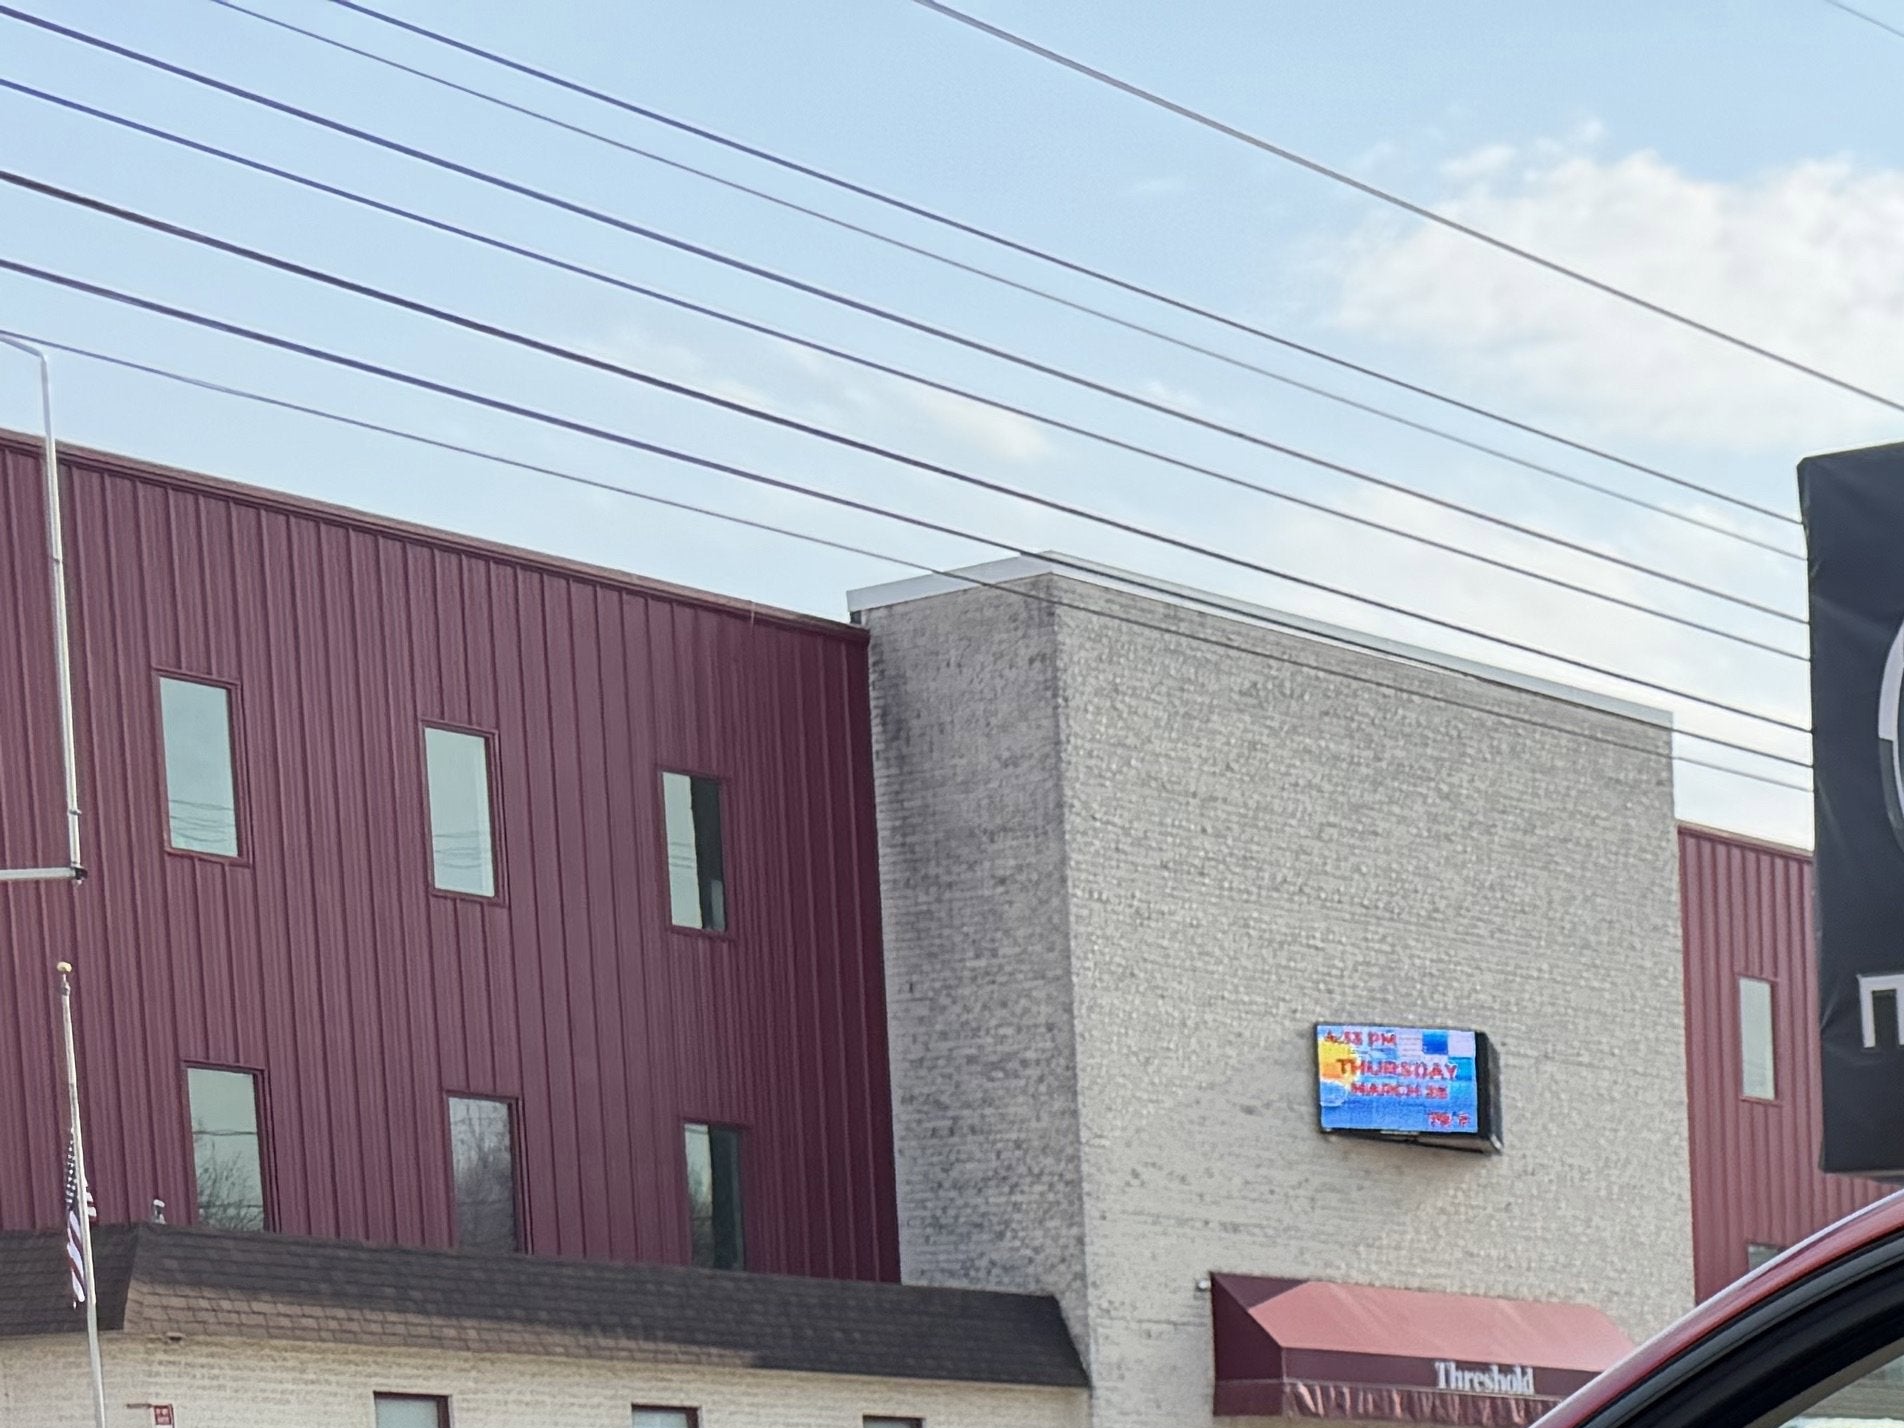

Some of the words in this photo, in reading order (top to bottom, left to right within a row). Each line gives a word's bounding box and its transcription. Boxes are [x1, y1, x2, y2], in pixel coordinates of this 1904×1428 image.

[1368, 1031, 1397, 1047] PM
[1335, 1058, 1457, 1080] THURSDAY
[1434, 1361, 1535, 1395] Threshold
